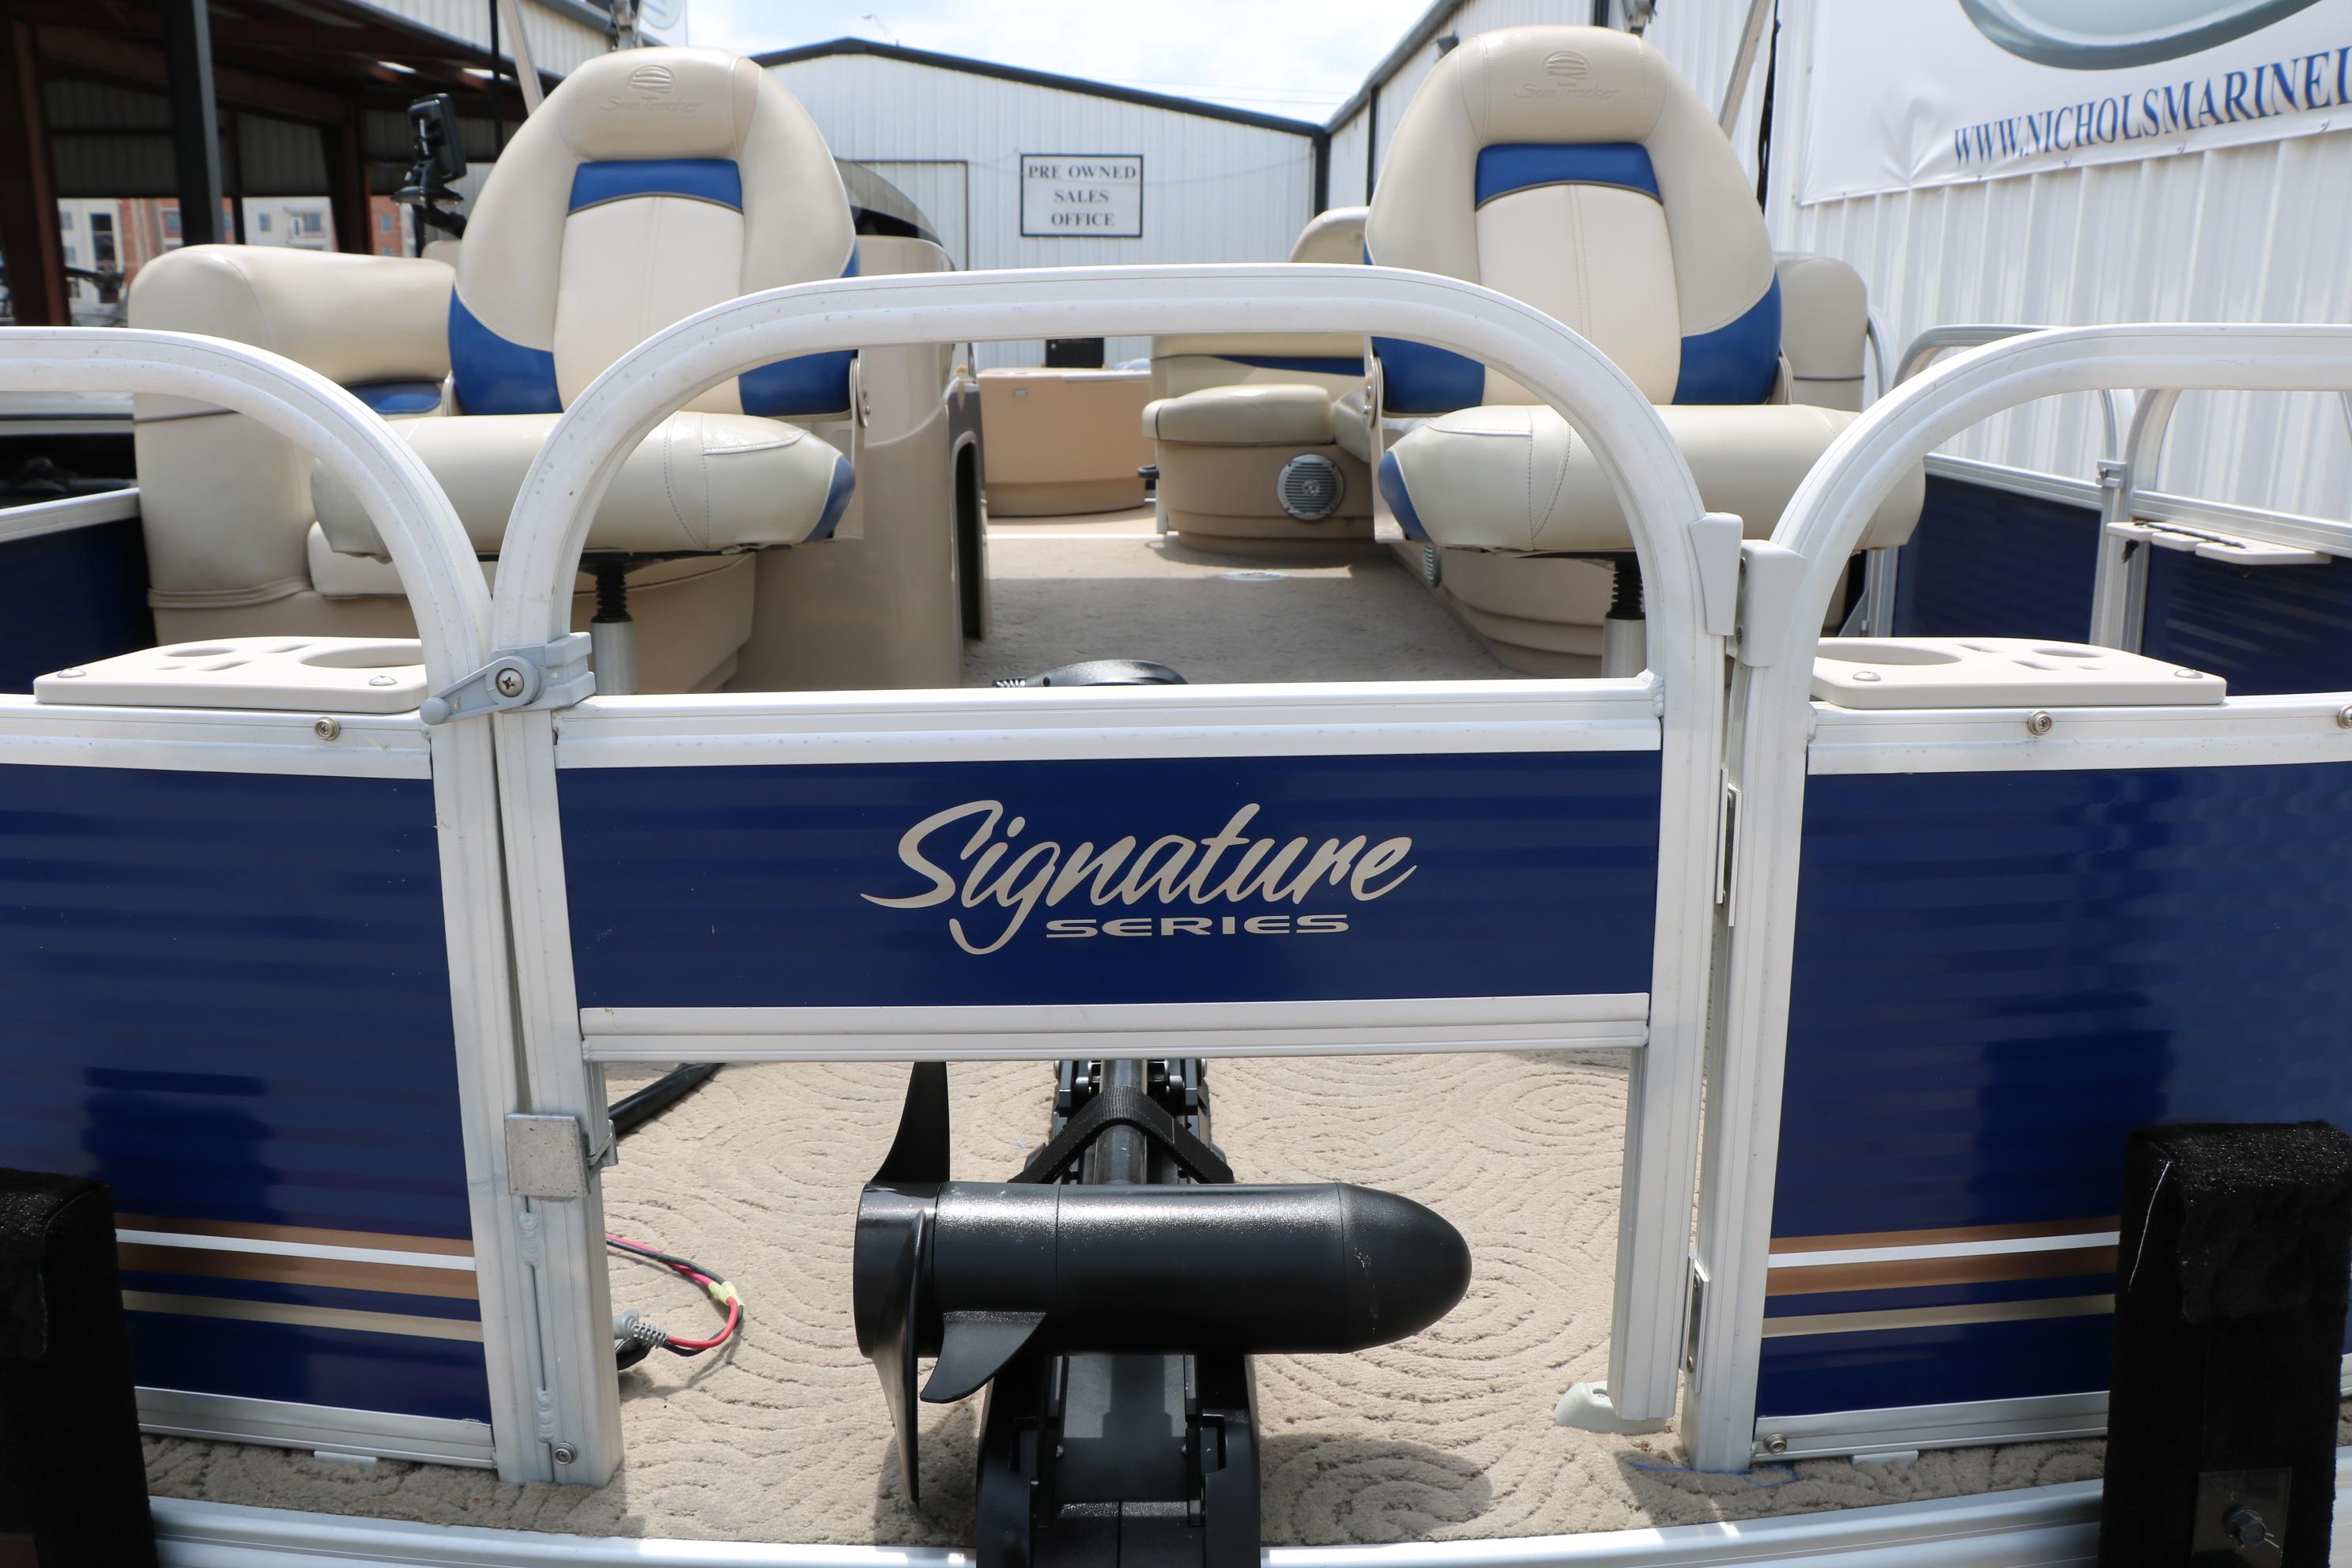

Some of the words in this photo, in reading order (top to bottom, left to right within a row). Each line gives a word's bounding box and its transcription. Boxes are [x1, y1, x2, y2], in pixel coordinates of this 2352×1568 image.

[1028, 164, 1061, 179] PRE
[1069, 164, 1136, 179] OWNED
[1054, 189, 1109, 203] SALES
[1051, 212, 1114, 226] OFFICE
[860, 799, 1417, 955] Signature
[1046, 914, 1349, 938] SERIES
